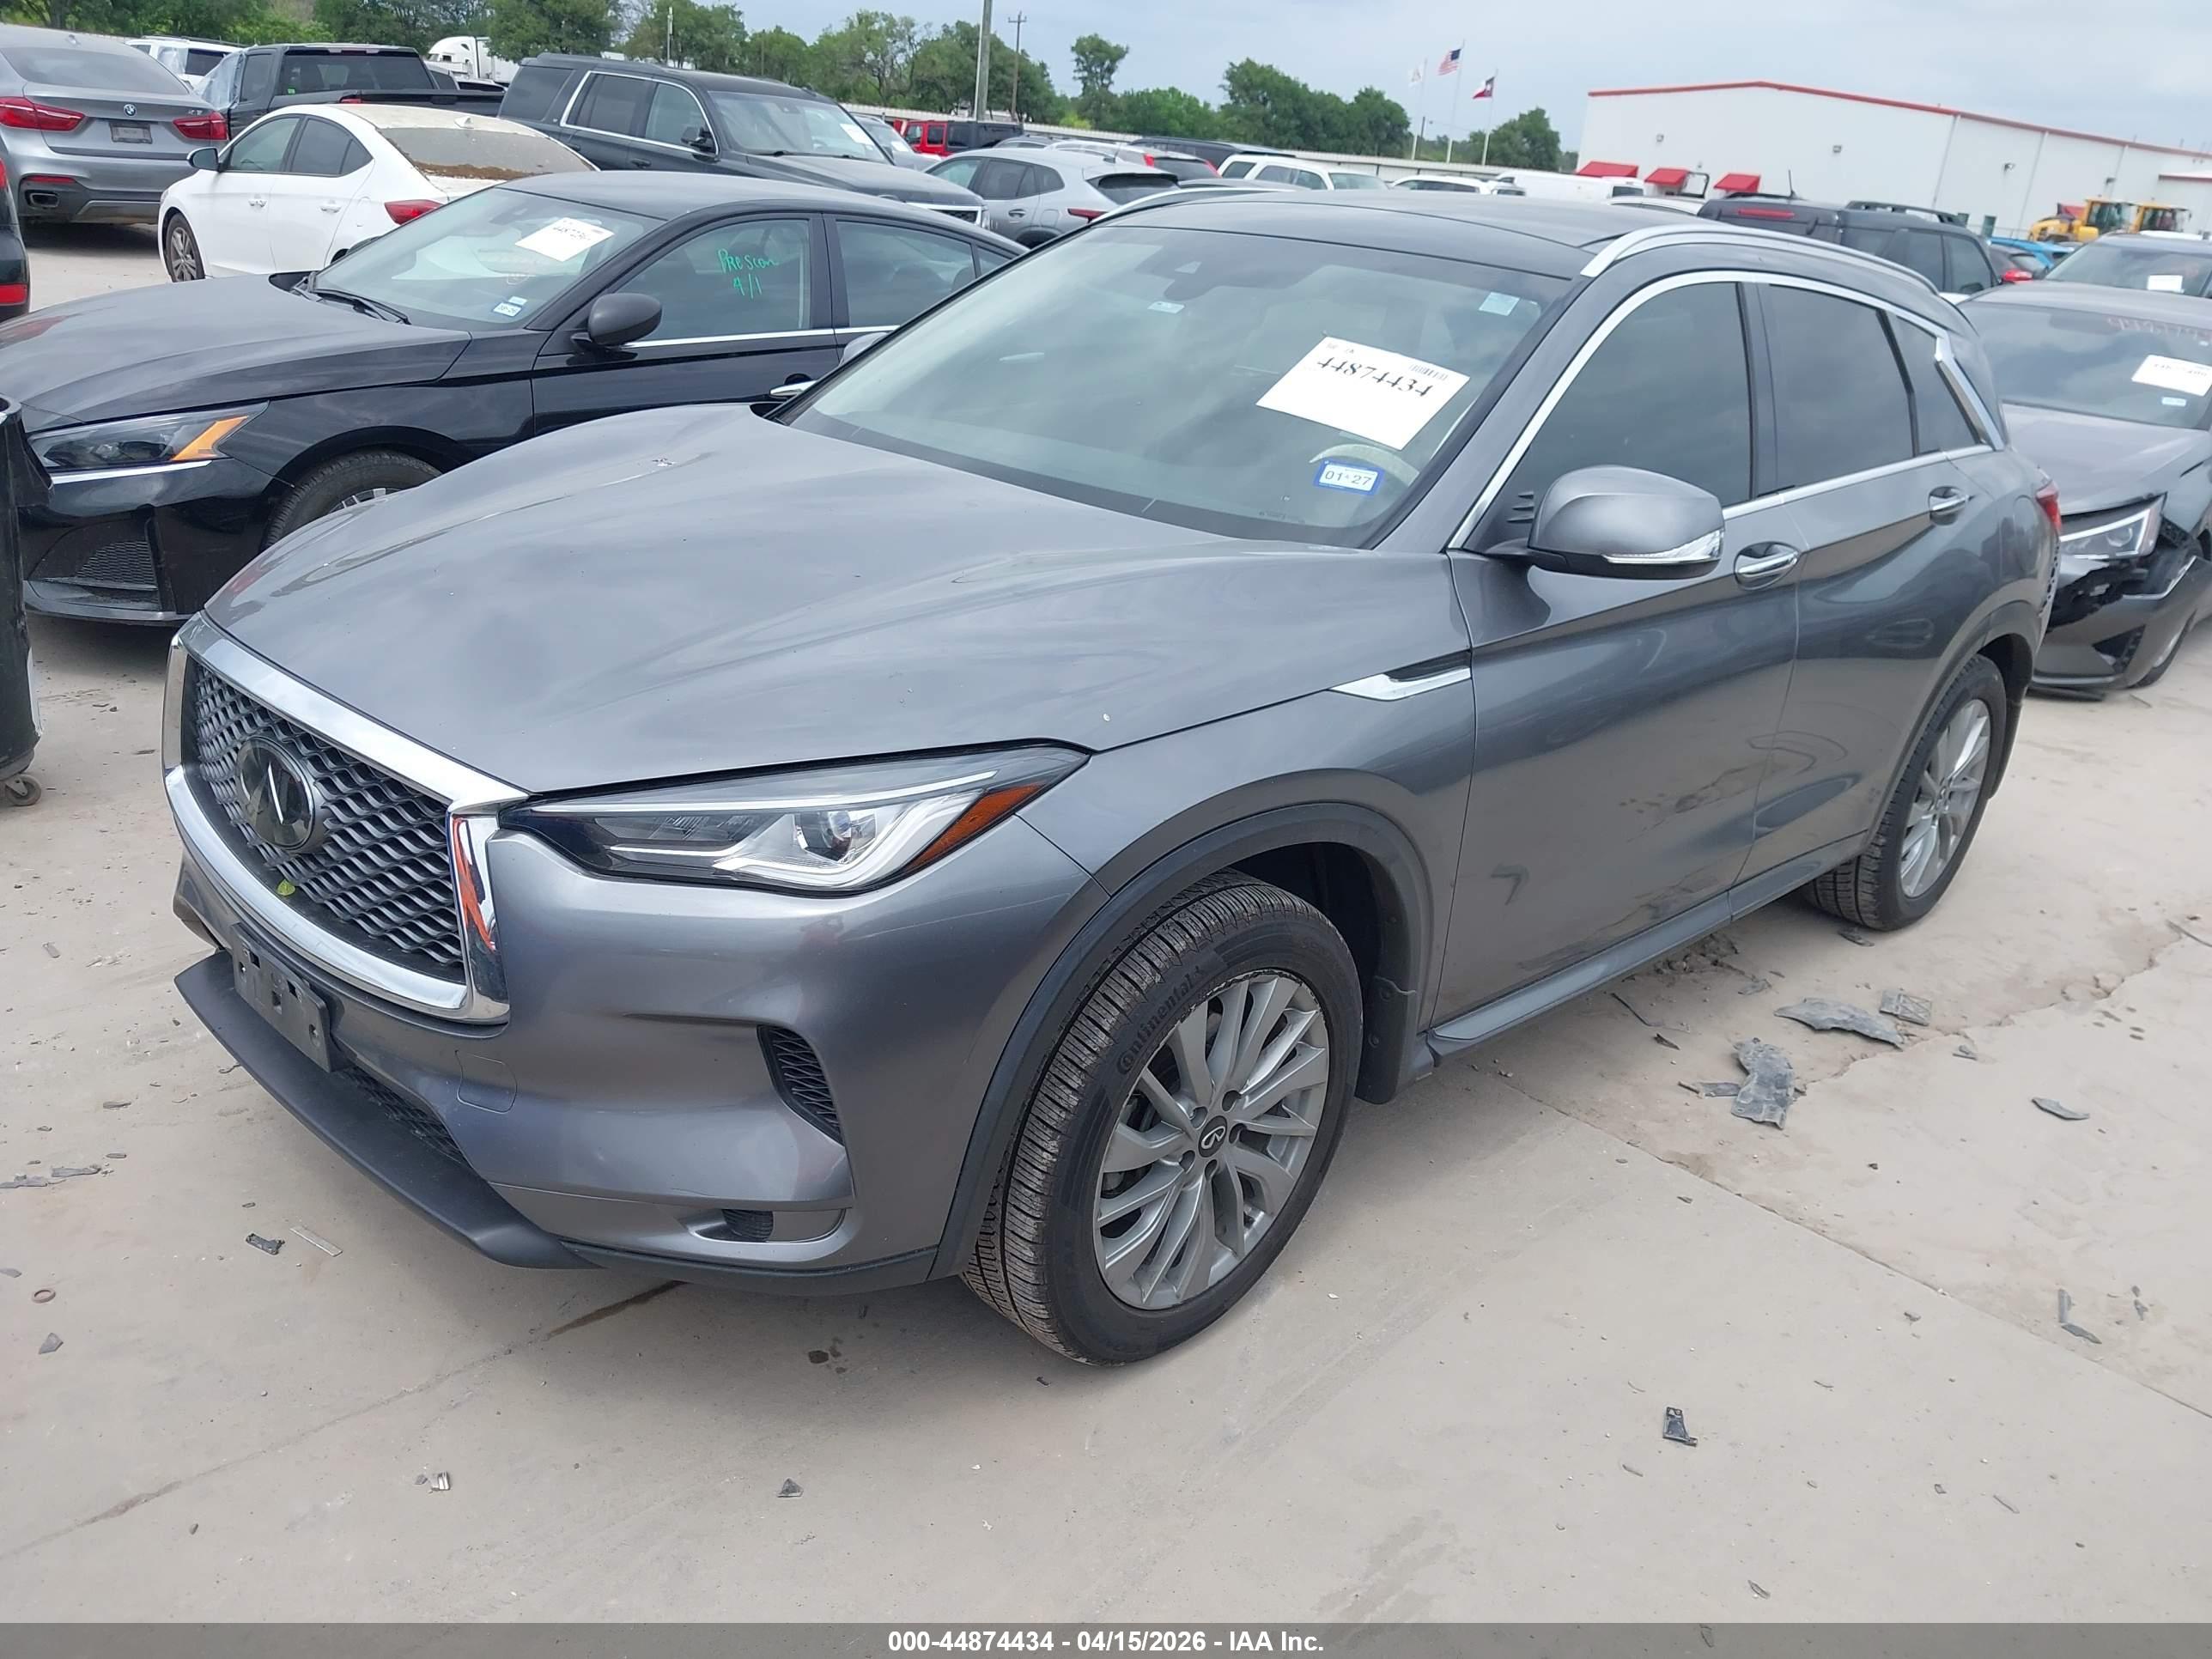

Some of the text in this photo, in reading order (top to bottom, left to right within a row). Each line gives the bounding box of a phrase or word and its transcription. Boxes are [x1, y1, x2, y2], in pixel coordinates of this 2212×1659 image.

[1316, 356, 1433, 398] 44874434
[1325, 470, 1372, 486] 01 27
